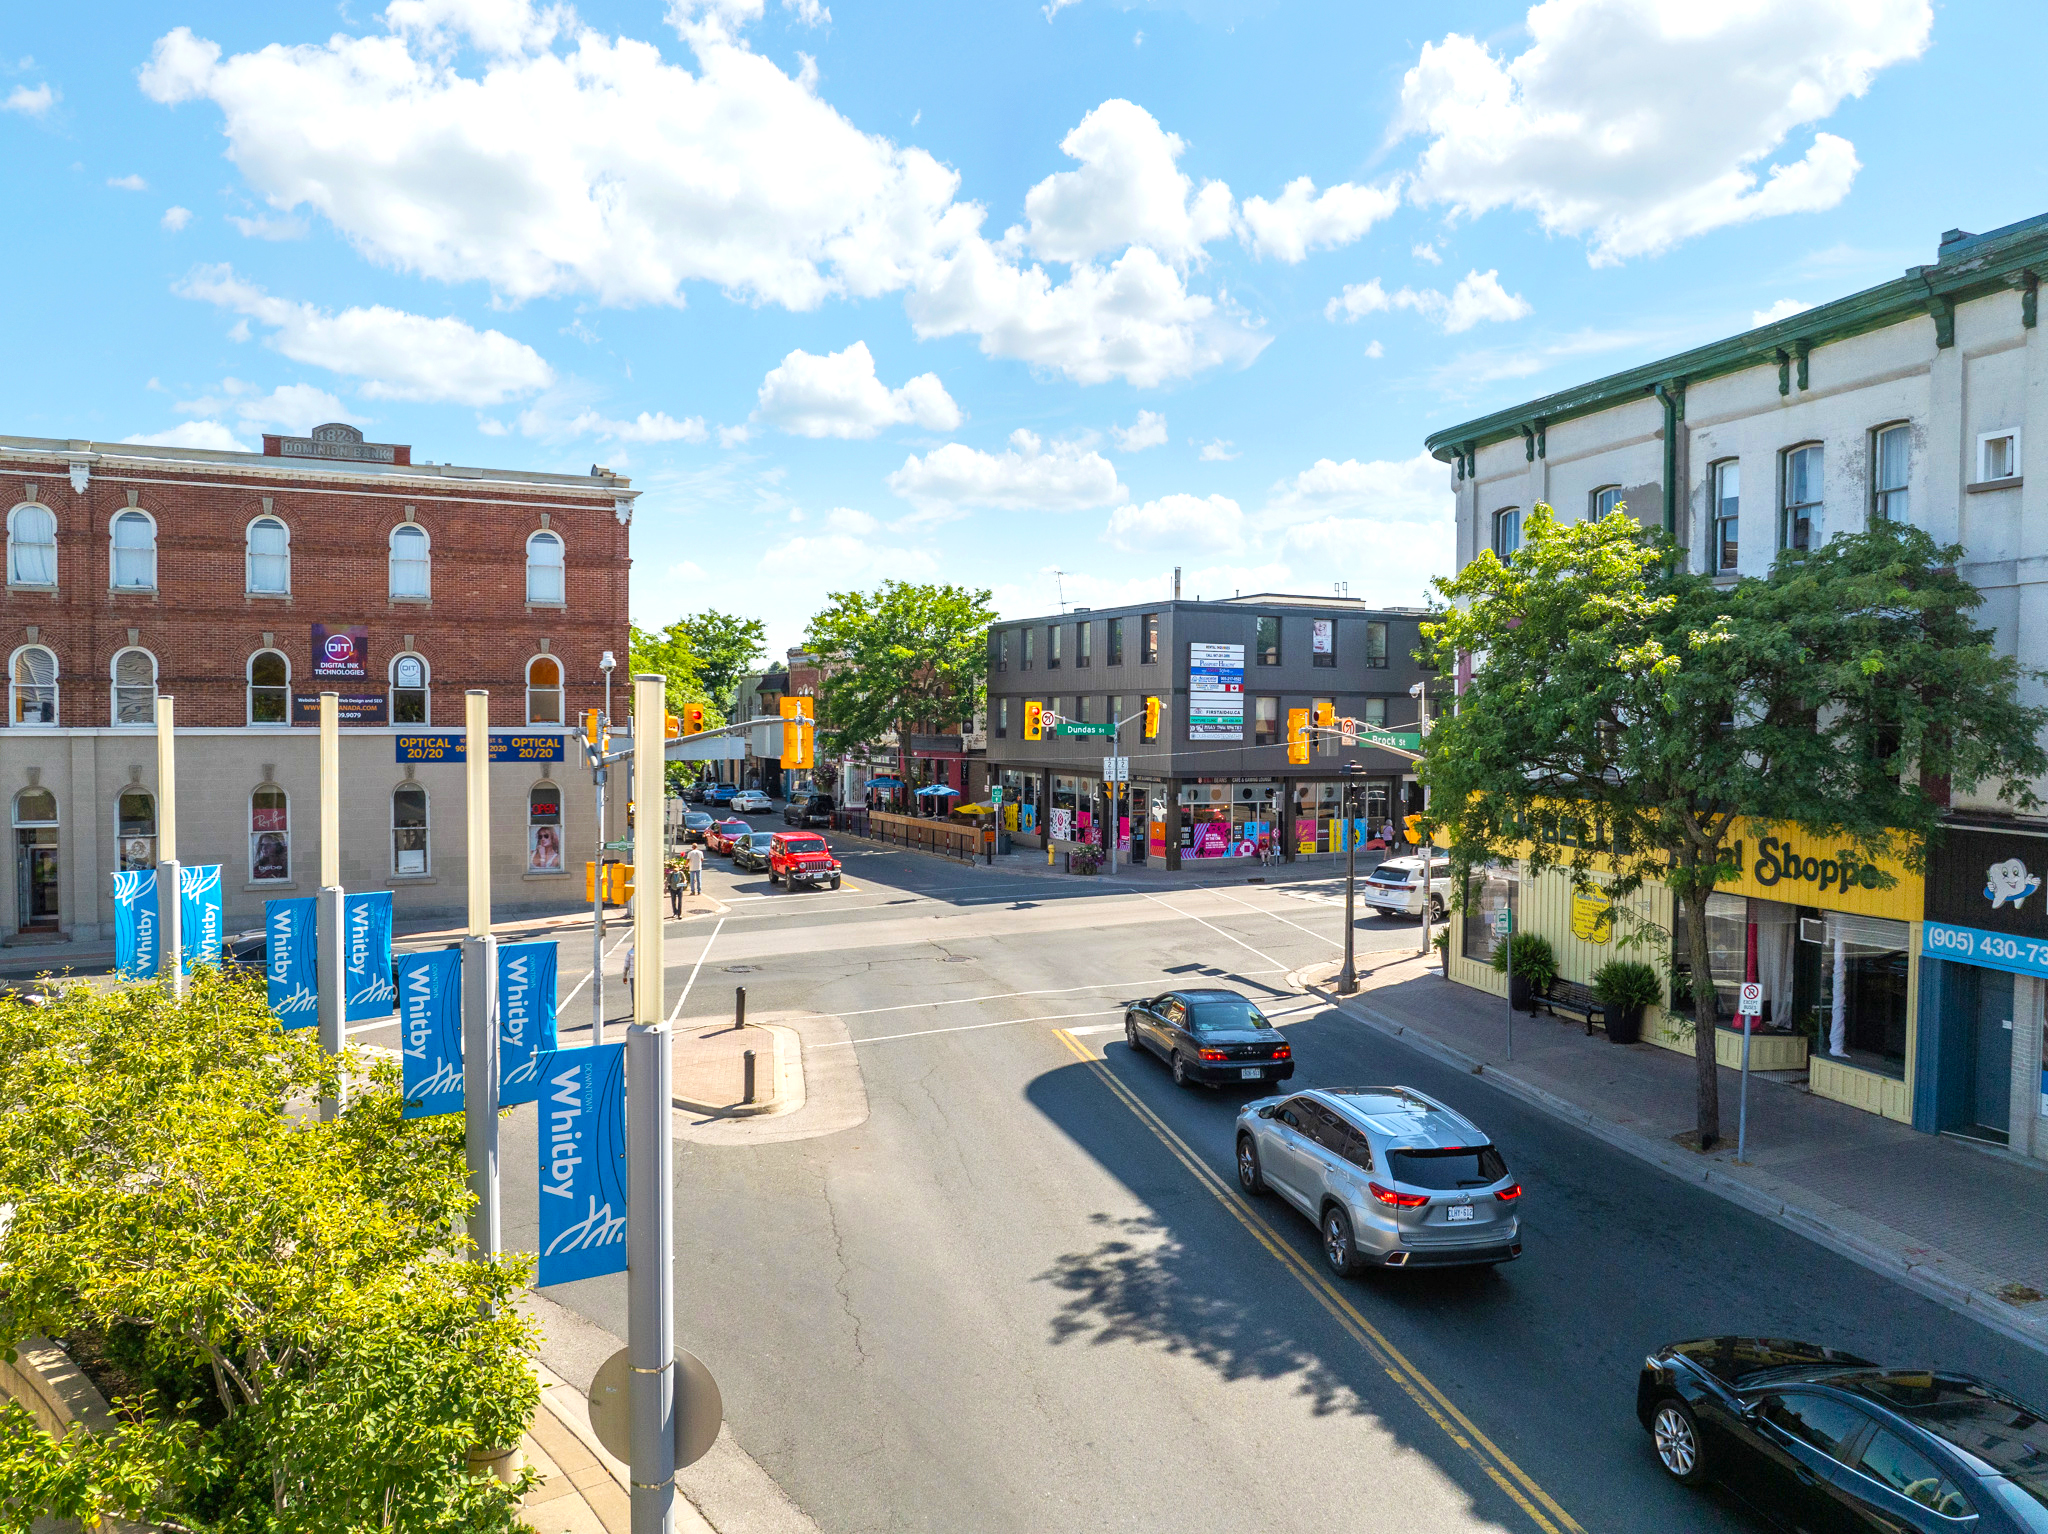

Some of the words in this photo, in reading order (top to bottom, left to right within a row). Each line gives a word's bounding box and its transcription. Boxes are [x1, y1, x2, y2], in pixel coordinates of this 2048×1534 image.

[284, 442, 349, 457] DOMINION
[319, 429, 355, 442] 1874
[328, 644, 350, 652] DIT
[400, 738, 451, 748] OPTICAL
[407, 749, 444, 759] 20/20
[512, 738, 560, 748] OPTICAL
[519, 748, 553, 758] 20/20
[1372, 735, 1396, 746] Brock
[532, 804, 556, 814] OPEN
[1754, 837, 1880, 894] Shoppe
[137, 909, 156, 972] Whitby
[202, 902, 220, 962] Whitby
[269, 909, 292, 984] Whitby
[348, 902, 369, 975] Whitby
[1928, 926, 1974, 956] (905)
[404, 964, 432, 1059] Whitby
[502, 955, 529, 1047] Whitby
[584, 1063, 592, 1113] DOWNTOWN
[542, 1064, 582, 1200] Whitby
